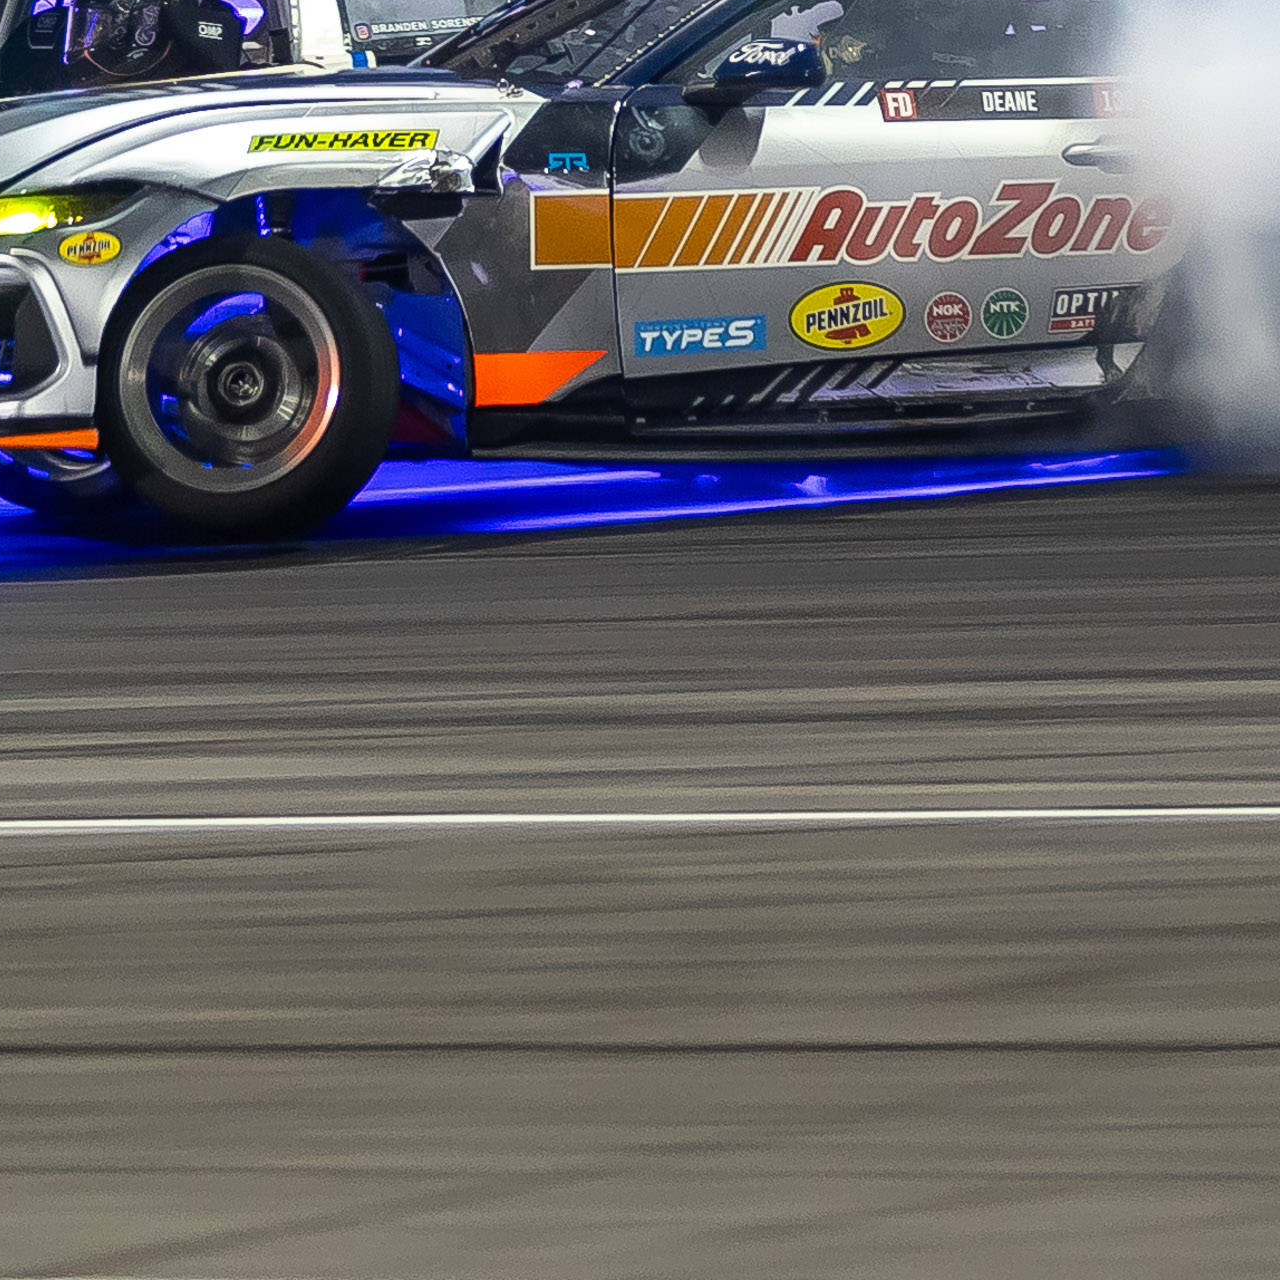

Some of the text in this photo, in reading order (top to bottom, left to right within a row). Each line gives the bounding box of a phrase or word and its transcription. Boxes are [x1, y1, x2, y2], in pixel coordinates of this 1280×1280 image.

[371, 20, 427, 34] BRANDEN
[729, 42, 797, 66] Ford
[885, 92, 915, 118] FD
[982, 90, 1039, 112] DEANE
[254, 132, 431, 150] FUN-HAVER
[787, 181, 1175, 263] AutoZone
[805, 298, 889, 334] PENNZOIL
[932, 303, 964, 317] NGK
[990, 300, 1020, 314] NTK
